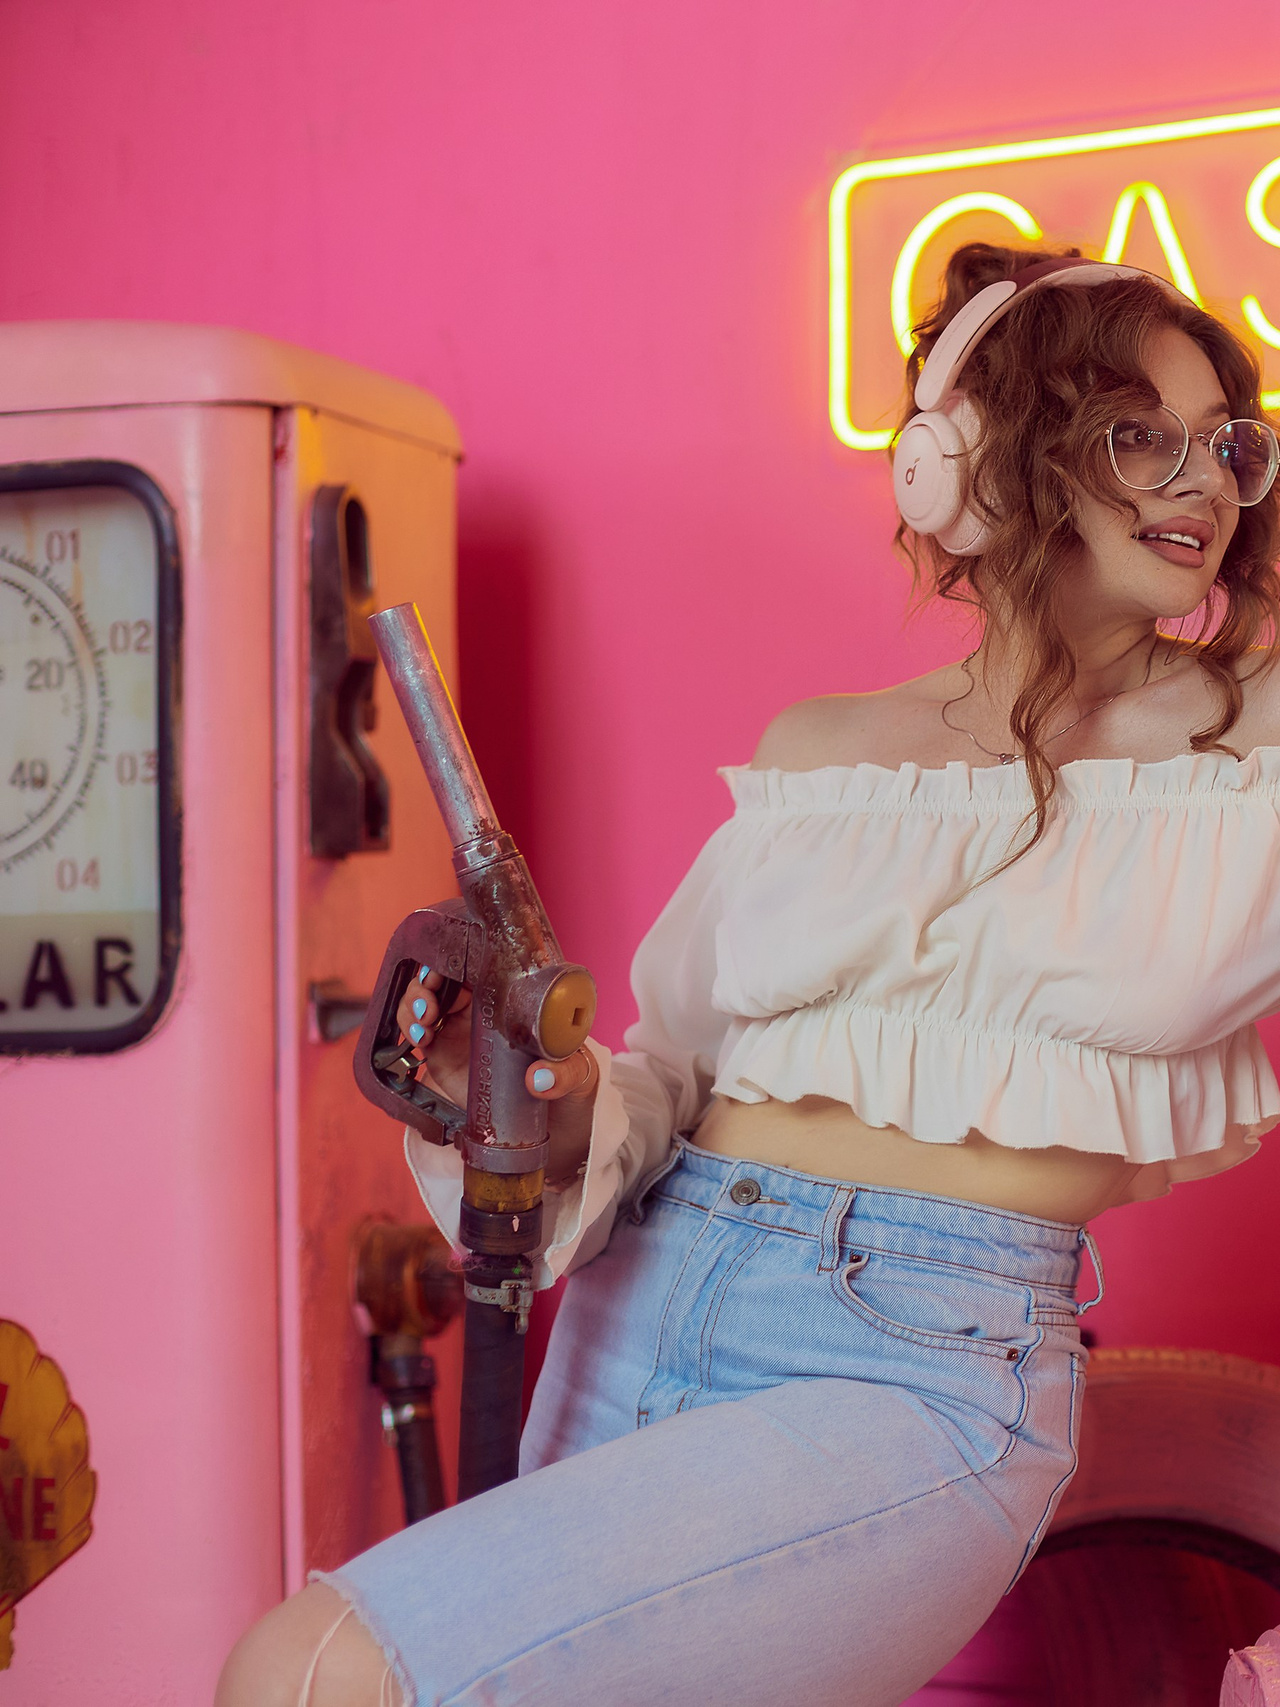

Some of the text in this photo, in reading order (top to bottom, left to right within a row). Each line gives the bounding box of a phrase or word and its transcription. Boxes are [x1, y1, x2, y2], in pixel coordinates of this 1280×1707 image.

[46, 530, 80, 563] 01
[109, 620, 151, 653] 02
[25, 657, 64, 691] 20
[9, 759, 48, 790] 40
[116, 752, 157, 786] 03
[56, 858, 99, 892] 04
[0, 938, 142, 1013] AR
